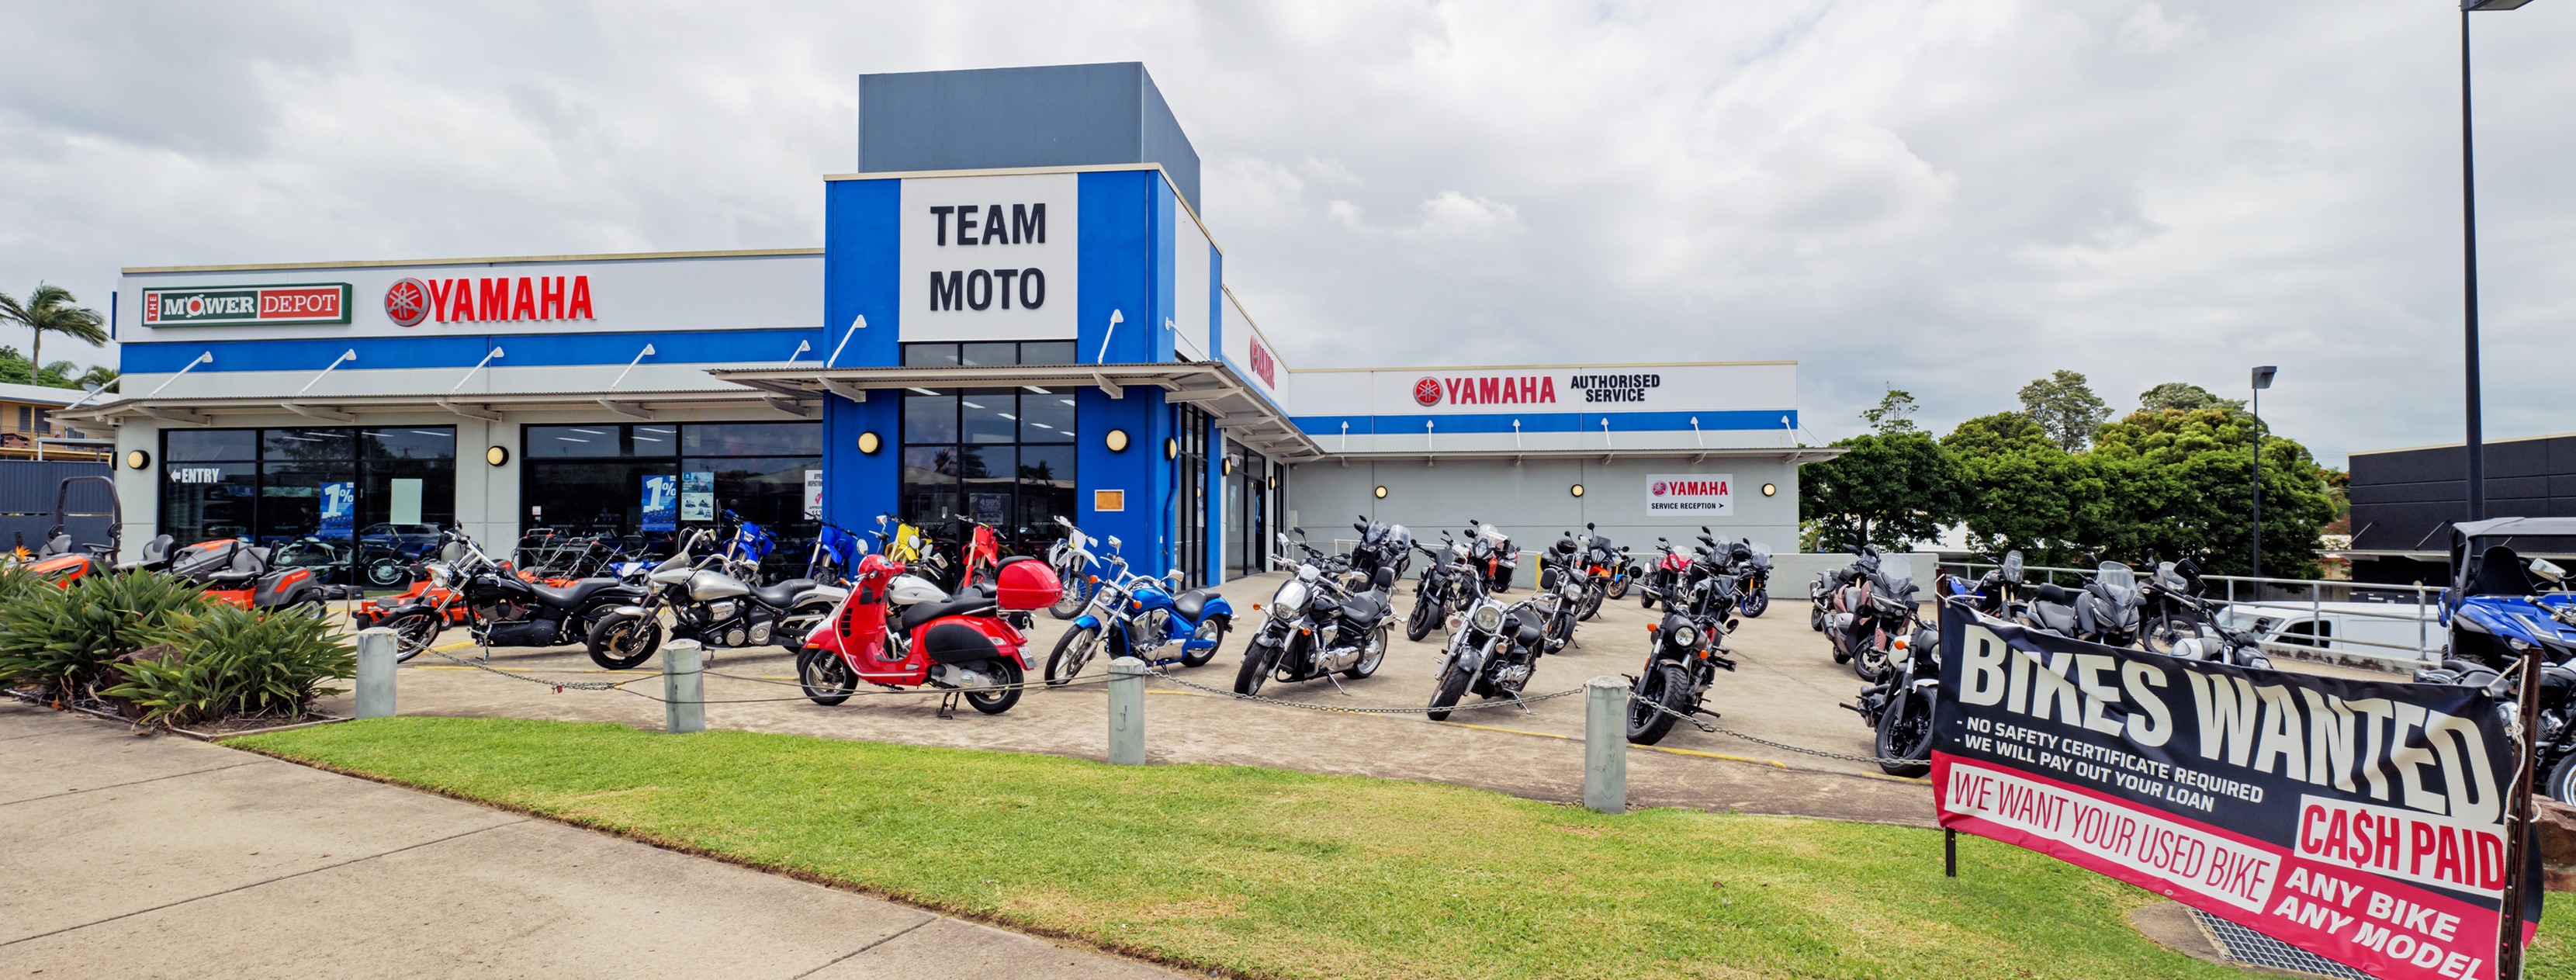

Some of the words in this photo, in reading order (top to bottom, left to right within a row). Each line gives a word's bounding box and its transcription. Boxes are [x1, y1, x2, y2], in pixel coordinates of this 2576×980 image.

[930, 203, 1045, 246] TEAM
[164, 294, 255, 317] MOWER
[264, 294, 336, 313] DEPOT
[428, 275, 594, 322] YAMAHA
[930, 268, 1045, 311] MOTO
[1445, 376, 1556, 404] YAMAHA
[1570, 374, 1660, 389] AUTHORISED
[1586, 388, 1645, 403] SERVICE
[182, 468, 220, 483] ENTRY
[642, 477, 676, 513] 1%
[1669, 481, 1728, 496] YAMAHA
[321, 483, 354, 519] 1%
[1959, 624, 2173, 747] BIKES
[2183, 668, 2501, 823] WANTED
[1965, 734, 1991, 753] WE
[1996, 741, 2036, 764] WILL
[2039, 752, 2072, 771] PAY
[2076, 761, 2113, 784] OUT
[2115, 771, 2164, 798] YOUR
[2166, 786, 2214, 812] LOAN
[1967, 717, 1991, 733] NO
[1995, 722, 2058, 749] SAFETY
[2062, 739, 2170, 780] CERTIFICATE
[2174, 767, 2263, 803] REQUIRED
[1955, 771, 1993, 812] WE
[1998, 781, 2069, 833] WANT
[2072, 802, 2136, 857] YOUR
[2138, 824, 2205, 879] USED
[2205, 847, 2270, 903] BIKE
[2301, 804, 2401, 871] CA$H
[2410, 820, 2505, 892] PAID
[2284, 867, 2363, 909] ANY
[2367, 891, 2461, 942] BIKE
[2273, 895, 2355, 935] ANY
[2352, 921, 2483, 980] MODEL
